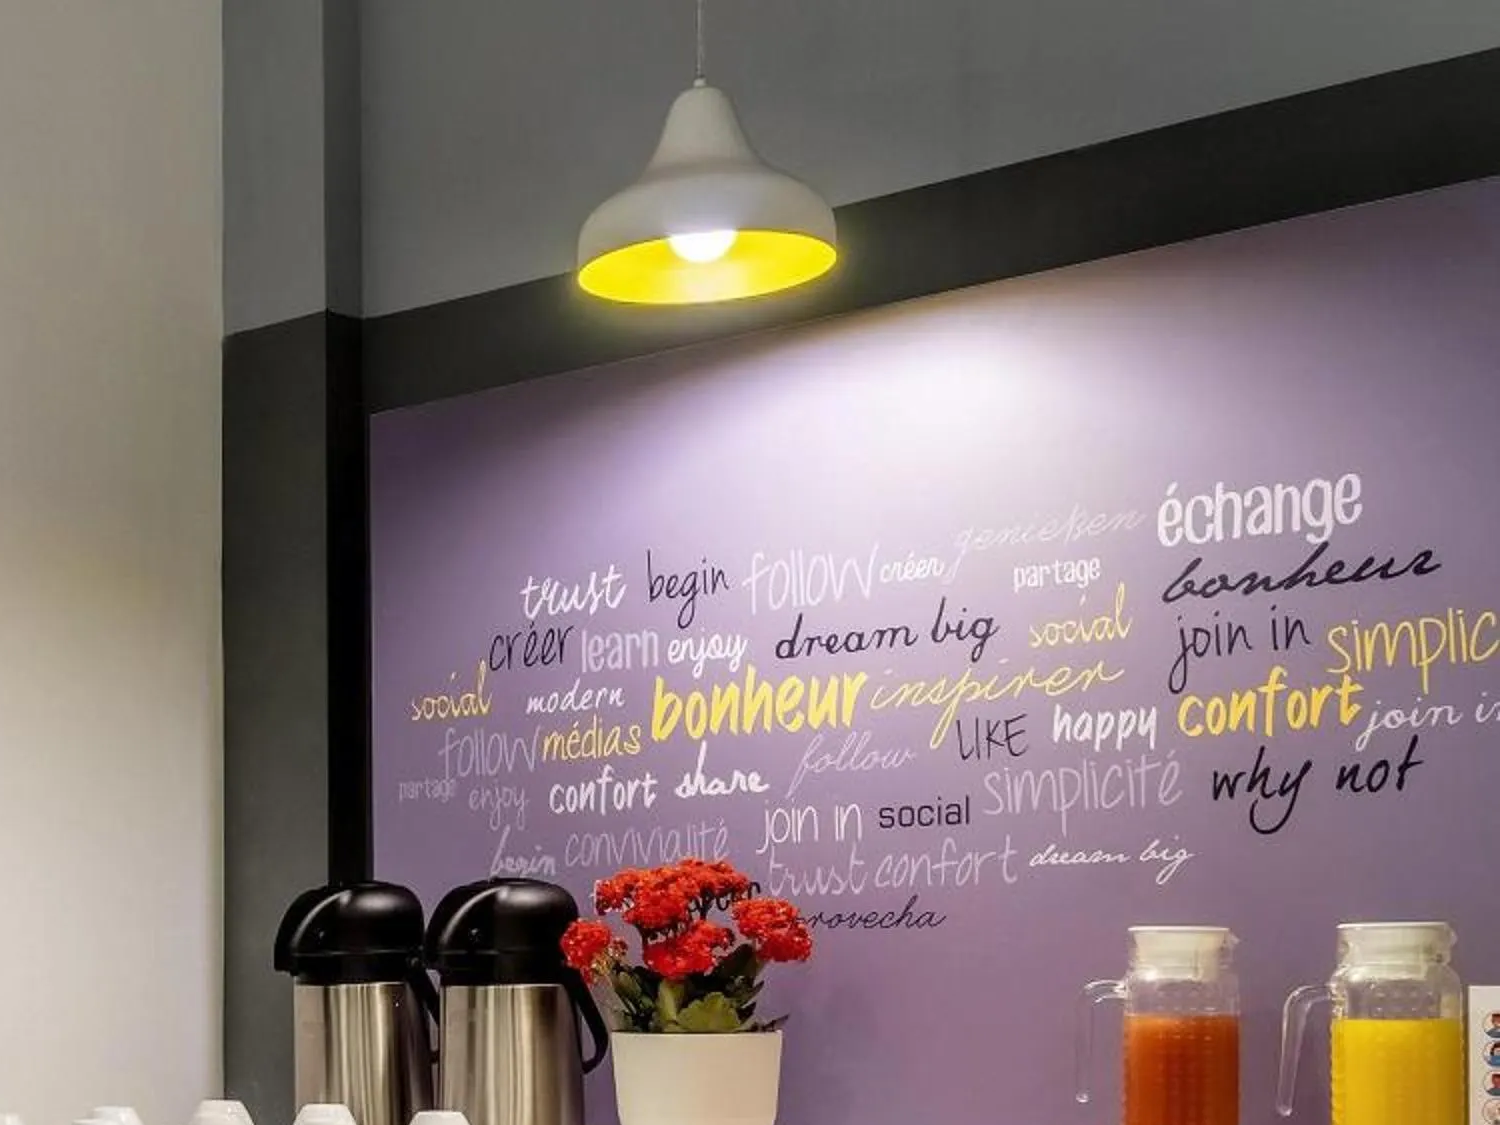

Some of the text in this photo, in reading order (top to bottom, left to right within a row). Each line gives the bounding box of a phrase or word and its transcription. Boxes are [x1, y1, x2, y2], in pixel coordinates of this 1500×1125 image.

[1157, 473, 1362, 547] échange
[520, 564, 627, 619] trust
[646, 548, 728, 628] begin
[743, 545, 878, 616] follow
[1013, 557, 1101, 593] partage
[1161, 541, 1442, 603] bonheur
[775, 596, 998, 662] dream big
[1028, 582, 1133, 647] social
[488, 620, 574, 671] créer
[580, 629, 658, 672] learn
[667, 631, 747, 679] enjoy
[1169, 604, 1310, 694] join in
[1326, 606, 1500, 695] simplic
[412, 659, 492, 721] social
[526, 678, 625, 714] modern
[651, 663, 869, 742] bonheur
[870, 657, 1125, 750] inspirer
[1177, 665, 1365, 738] confort
[438, 724, 540, 780] follow
[542, 716, 642, 763] médias
[956, 714, 1030, 761] LIKE
[1053, 704, 1157, 752] happy
[1355, 699, 1463, 752] join
[549, 764, 658, 816] confort
[675, 740, 770, 799] share
[786, 730, 918, 799] follow
[1212, 734, 1424, 835] why not
[469, 780, 529, 831] enjoy
[878, 796, 971, 829] social
[982, 750, 1184, 836] simplicité
[755, 801, 863, 855] join in
[768, 843, 868, 897] trust
[874, 837, 1019, 889] confort
[1028, 834, 1196, 885] dream big
[796, 894, 948, 930] rovecha
